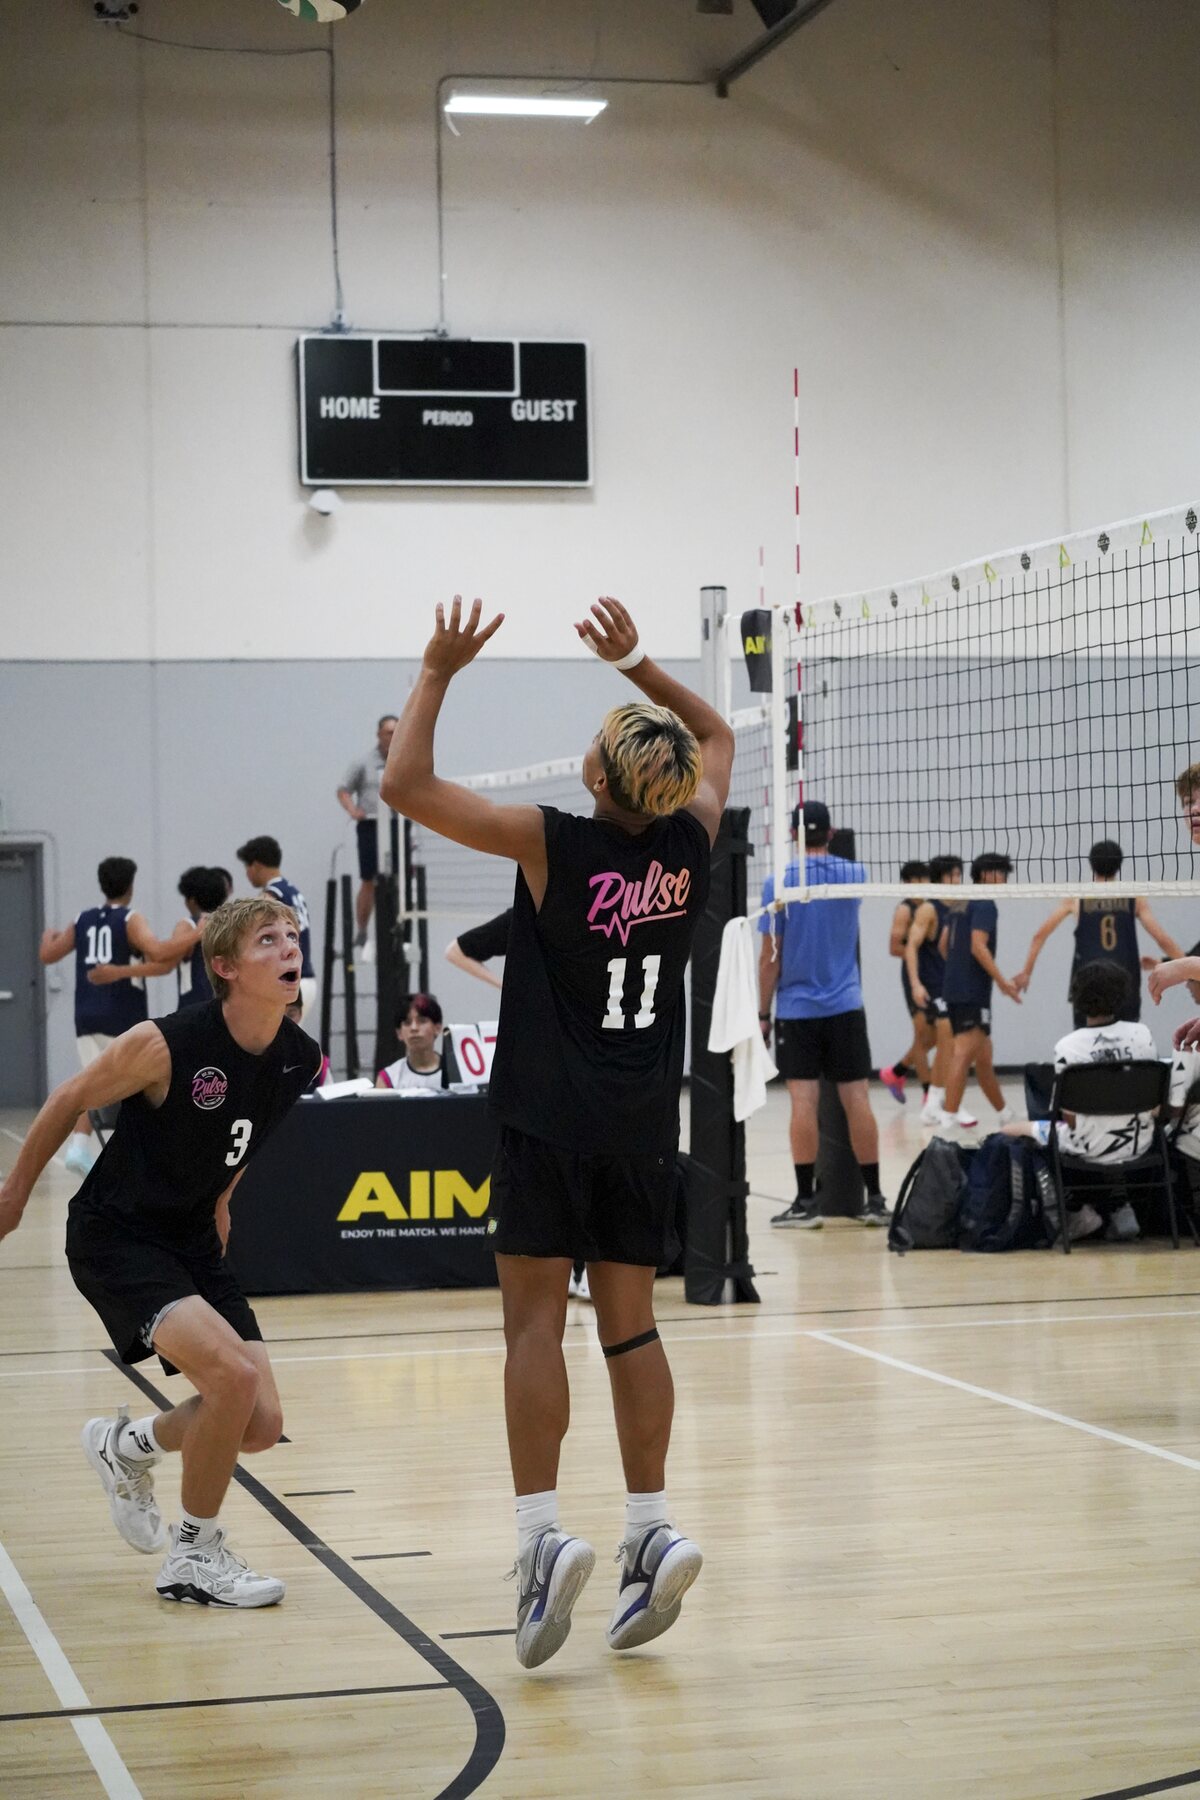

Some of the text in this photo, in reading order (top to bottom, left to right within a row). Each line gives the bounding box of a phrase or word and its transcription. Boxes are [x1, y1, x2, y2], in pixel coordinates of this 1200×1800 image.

[320, 397, 381, 419] HOME
[422, 410, 474, 426] PERIOD
[511, 399, 577, 421] GUEST
[587, 860, 691, 923] Pulse
[85, 925, 113, 964] 10
[1101, 915, 1118, 951] 6
[601, 954, 661, 1029] 11
[461, 1036, 498, 1076] 0
[192, 1076, 228, 1097] Pulse
[224, 1119, 253, 1167] 3
[336, 1169, 492, 1222] AIM
[340, 1229, 374, 1239] ENJOY
[376, 1228, 397, 1238] THE
[398, 1227, 438, 1237] MATCH.
[440, 1227, 457, 1236] WE
